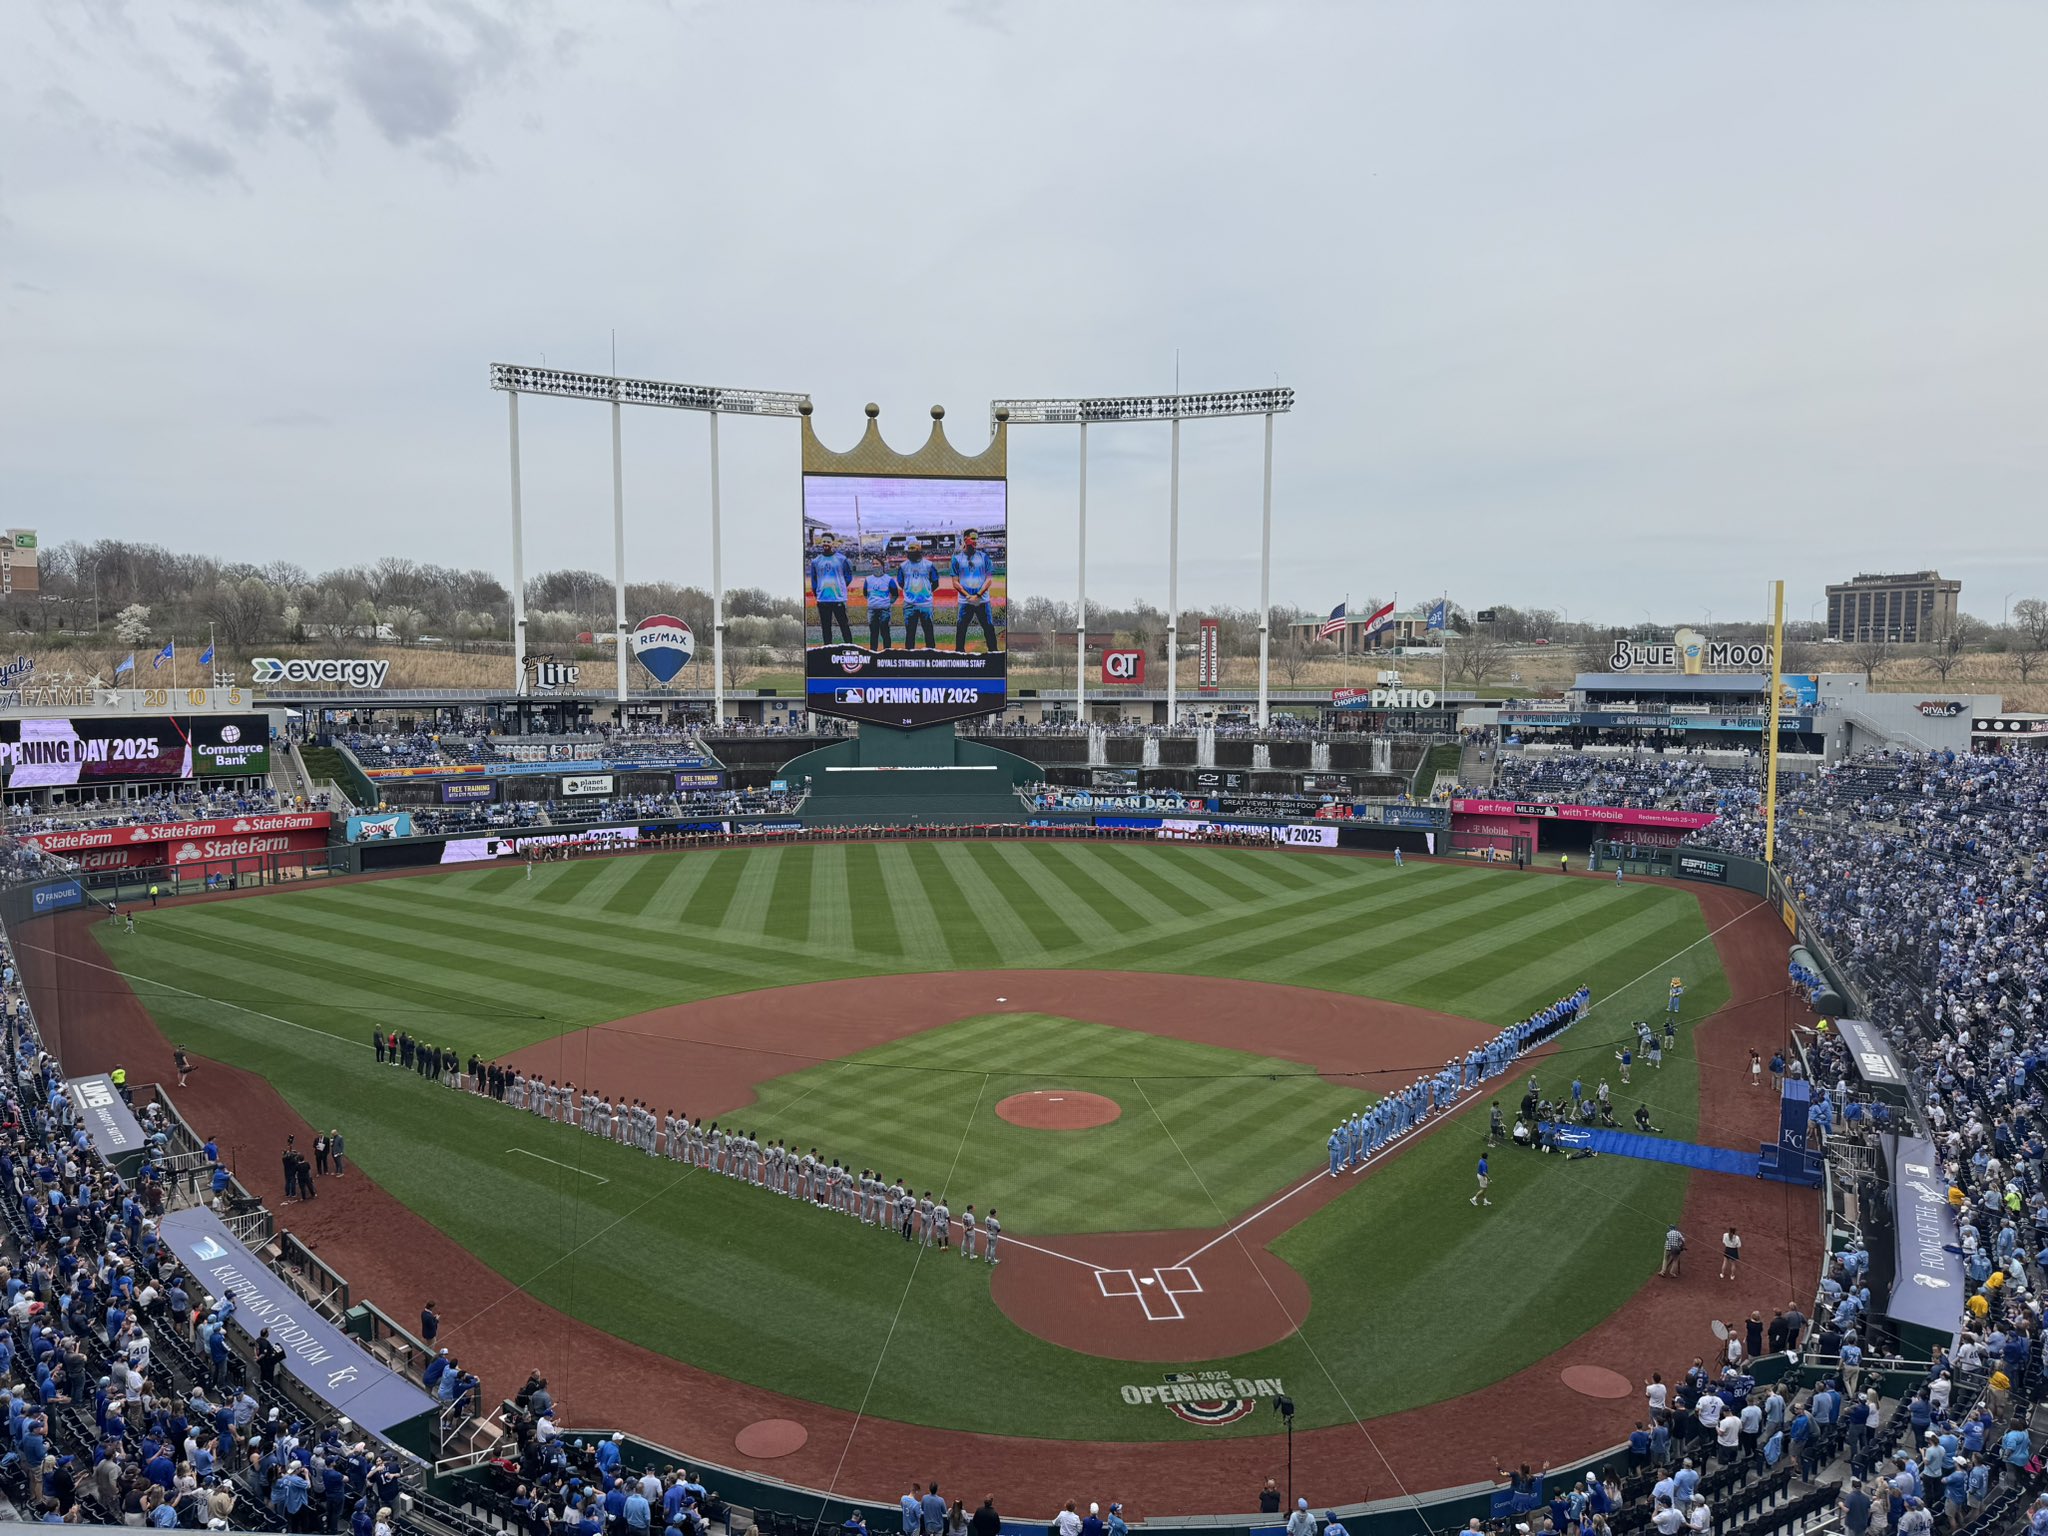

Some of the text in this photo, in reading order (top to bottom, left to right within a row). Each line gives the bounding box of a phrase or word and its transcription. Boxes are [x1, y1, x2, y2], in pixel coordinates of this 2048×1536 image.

[640, 632, 687, 646] RE/MAX
[522, 653, 554, 669] Miller
[831, 655, 871, 664] OPENING DAY
[1609, 640, 1675, 671] BLUE
[876, 659, 986, 668] ROYALS STRENGTH & CONDITIONING STAFF
[1106, 652, 1138, 678] QT
[287, 661, 388, 687] evergy
[536, 662, 580, 690] Lite
[20, 685, 97, 707] FAME
[143, 688, 169, 707] 20
[187, 688, 207, 706] 10
[229, 687, 241, 705] 5
[866, 687, 978, 704] OPENING DAY 2025
[1334, 689, 1355, 698] PRICE
[1371, 689, 1436, 708] PATIO
[1333, 695, 1367, 707] CHOPPER
[1922, 707, 1957, 715] RIVALS
[1523, 714, 1551, 722] OPENING
[1627, 715, 1655, 724] OPENING
[1671, 717, 1688, 725] 2025
[1737, 718, 1763, 728] OPENIN
[74, 739, 110, 762] DAY
[112, 738, 160, 761] 2025
[198, 744, 264, 755] Commerce
[215, 755, 247, 766] Bank
[463, 784, 490, 792] TRAINING
[580, 779, 603, 787] planet
[583, 784, 608, 792] fitness
[1062, 796, 1141, 808] FOUNTAIN
[1145, 798, 1187, 809] DECK
[1385, 807, 1427, 819] carbliss
[1478, 804, 1493, 813] get
[1494, 804, 1512, 812] free
[1562, 809, 1582, 817] with
[1583, 809, 1624, 820] T-Mobile
[1638, 813, 1662, 821] Redeem
[1662, 815, 1680, 823] March
[364, 823, 394, 834] SONIC
[1481, 825, 1509, 835] Mobile
[1295, 828, 1322, 843] 2025
[1637, 832, 1677, 846] Mobile
[1686, 868, 1721, 878] SPORTSBOOK
[45, 889, 77, 901] FANDUEL
[1860, 1053, 1892, 1078] UMB
[80, 1080, 114, 1108] UMB
[1783, 1129, 1803, 1149] KC
[1915, 1205, 1939, 1224] THE
[1917, 1223, 1940, 1238] OF
[1919, 1237, 1945, 1271] HOME
[209, 1264, 359, 1390] KAUFFMAN STADIUM KC
[133, 1345, 148, 1355] 40
[1197, 1371, 1231, 1381] 2025
[1696, 1378, 1703, 1388] 6
[1121, 1378, 1285, 1405] OPENING DAY
[1711, 1405, 1716, 1414] 7
[1572, 1500, 1578, 1510] 7
